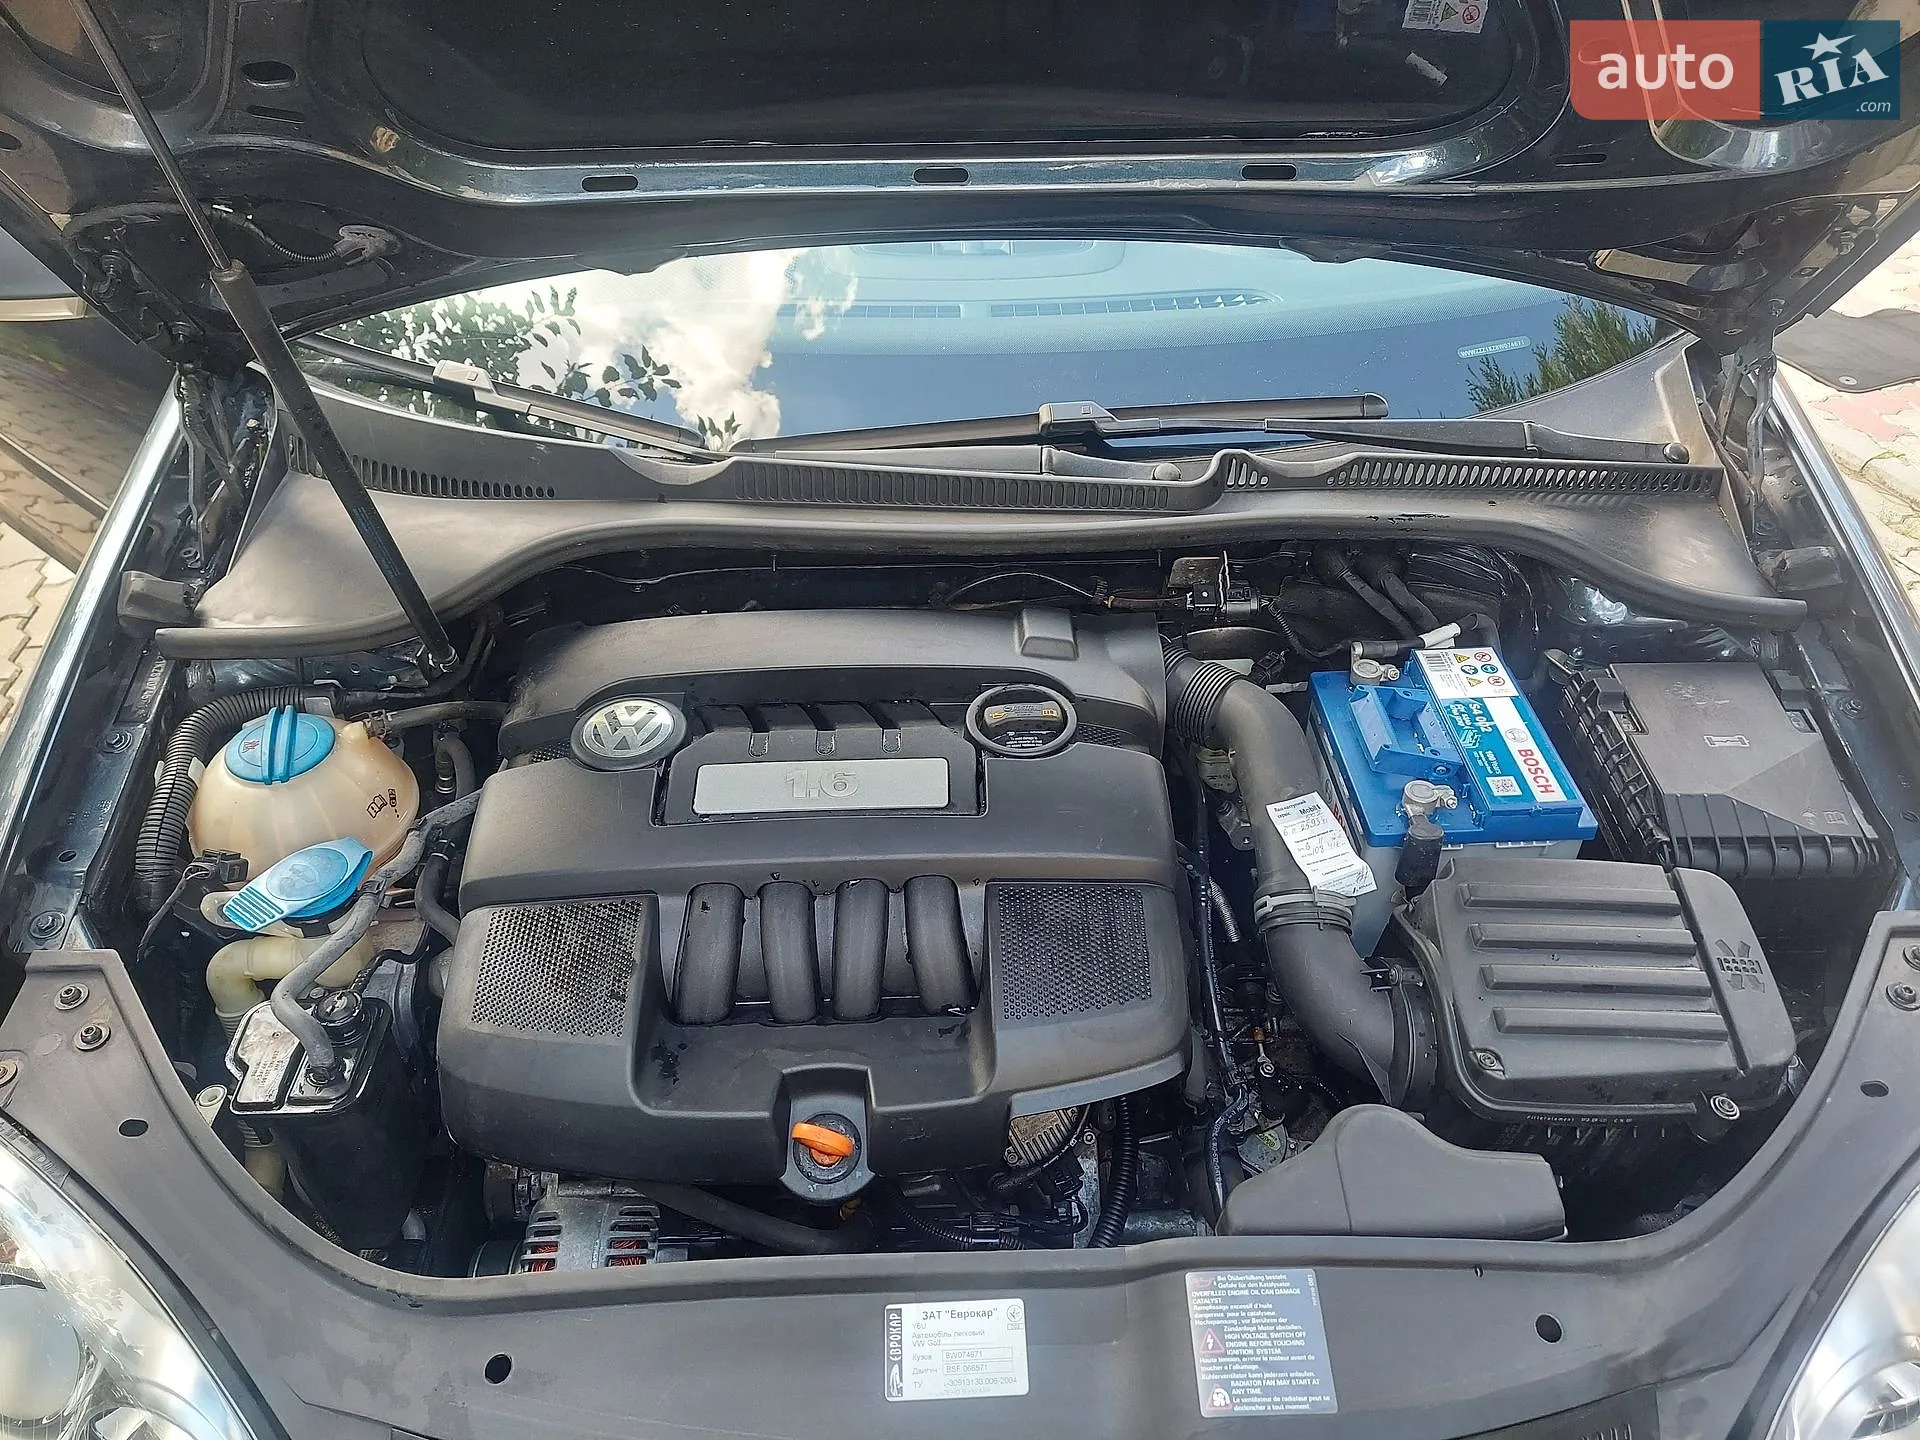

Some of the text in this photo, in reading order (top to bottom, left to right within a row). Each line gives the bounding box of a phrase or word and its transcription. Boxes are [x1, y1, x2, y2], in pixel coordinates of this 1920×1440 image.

[784, 769, 860, 799] 1.6
[1517, 749, 1555, 794] BOSCH
[922, 1310, 942, 1320] ЗАТ
